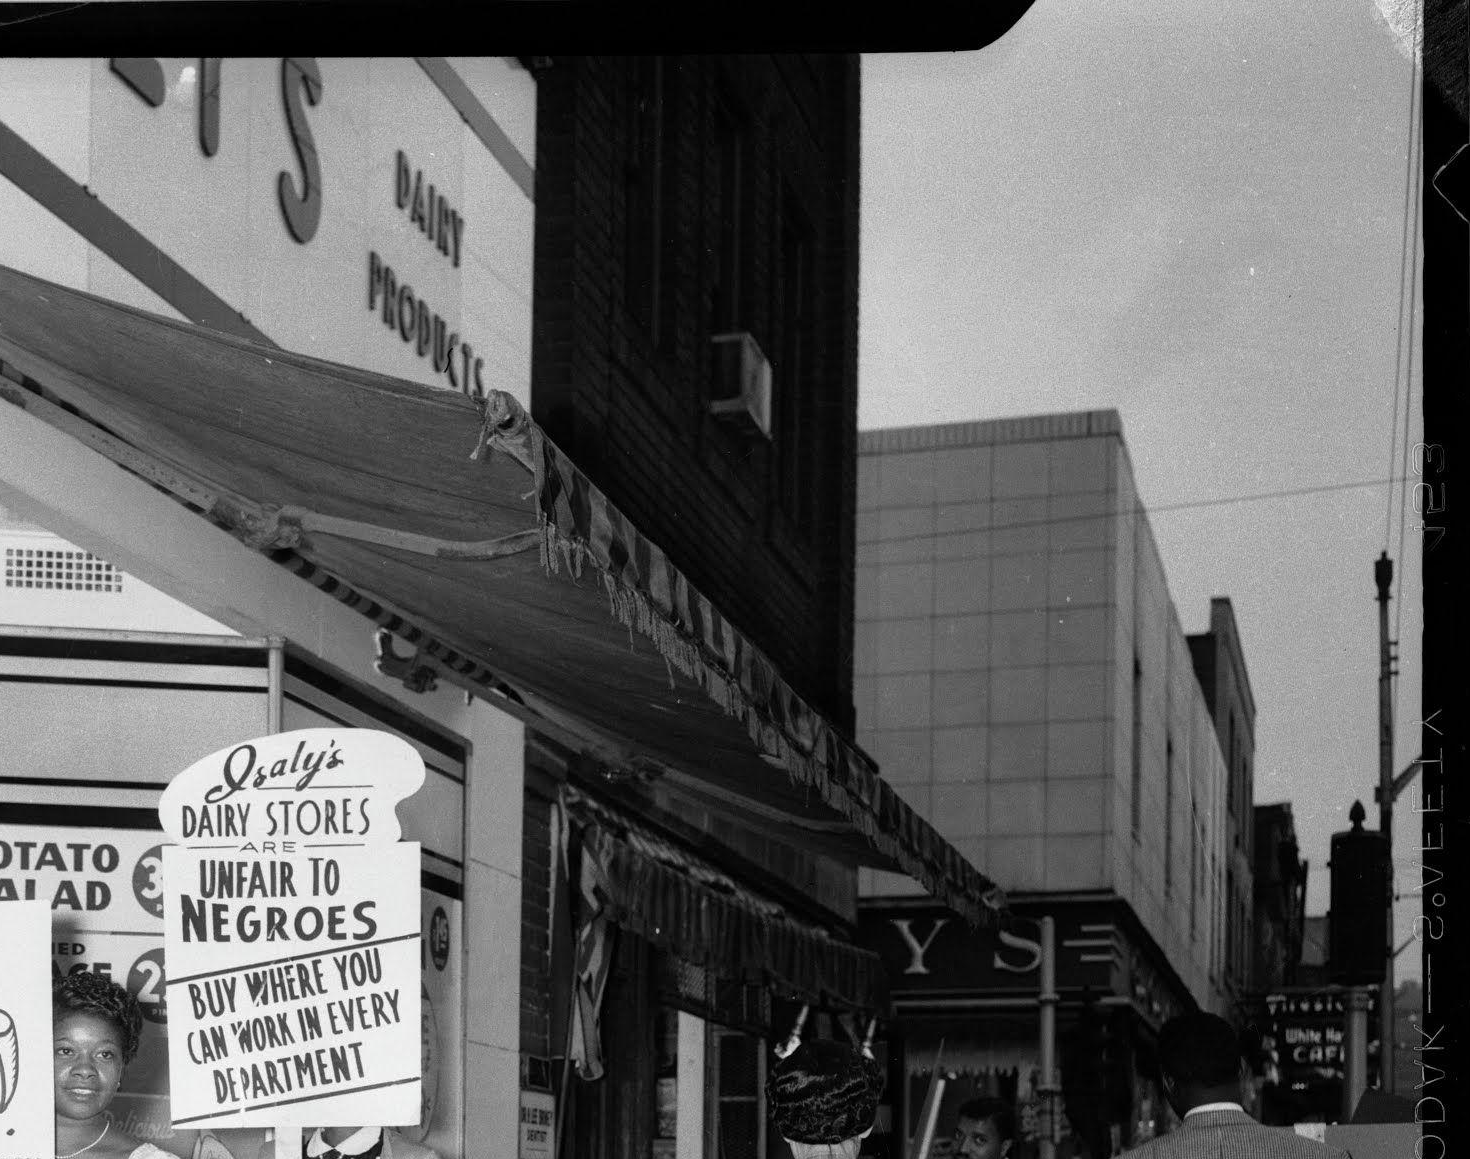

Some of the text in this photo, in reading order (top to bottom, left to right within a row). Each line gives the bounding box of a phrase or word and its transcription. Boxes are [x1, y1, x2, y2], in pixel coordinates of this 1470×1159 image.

[396, 150, 464, 268] DAIRY
[368, 251, 484, 399] PRODUCTS
[205, 739, 344, 804] Isaly's
[183, 798, 369, 838] DAIRY STORES
[238, 841, 297, 854] ARE
[200, 858, 339, 899] UNFAIR TO
[181, 895, 378, 943] NEGROES
[188, 948, 382, 1020] BUY WHERE YOU
[187, 989, 400, 1064] CAN WORK IN EVERY
[213, 1043, 365, 1104] DEPARTMENT
